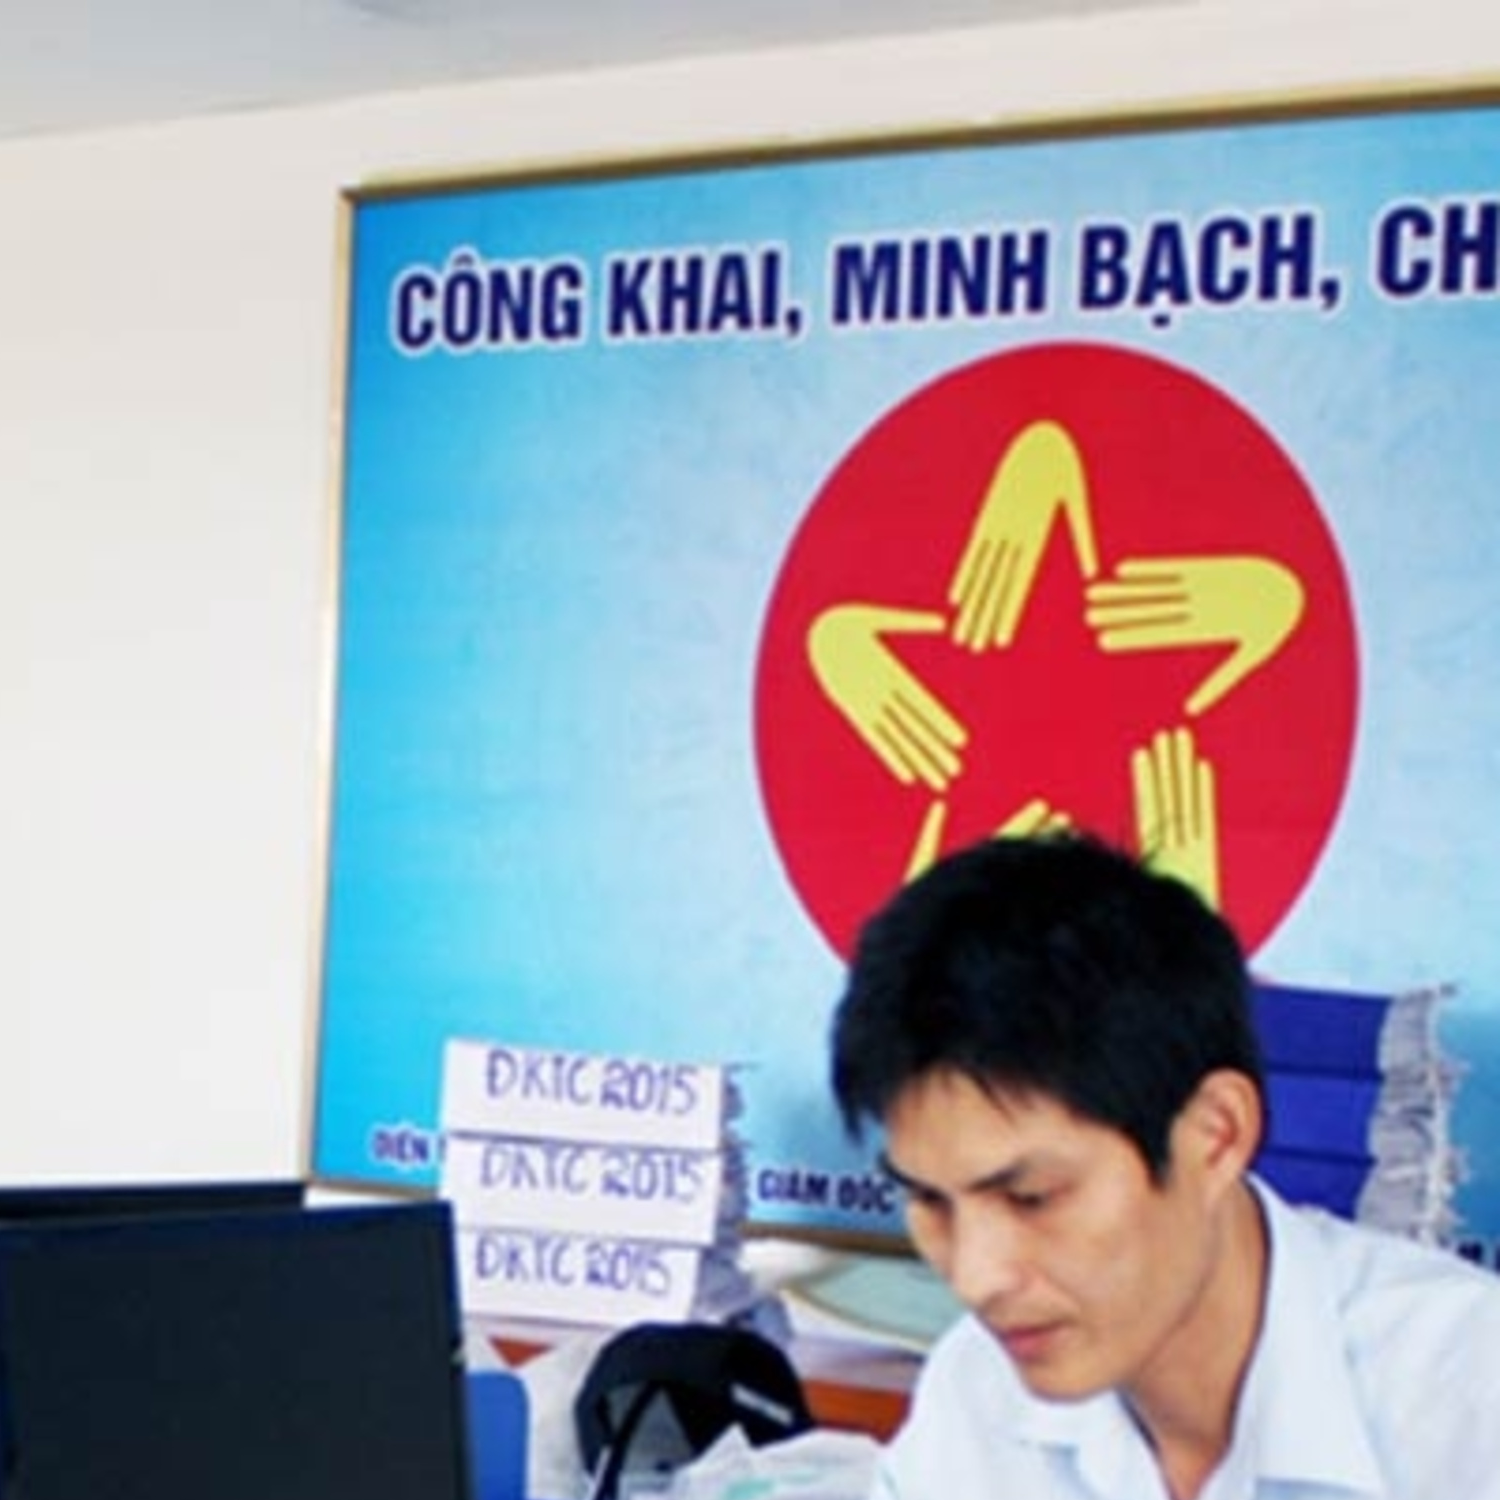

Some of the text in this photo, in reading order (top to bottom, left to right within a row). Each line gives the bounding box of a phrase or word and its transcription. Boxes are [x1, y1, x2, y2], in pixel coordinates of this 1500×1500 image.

[398, 252, 583, 350] CÔNG
[606, 249, 802, 338] KHAI,
[831, 227, 1049, 326] MINH
[1078, 213, 1340, 328] BẠCH,
[600, 1058, 699, 1116] 2015
[600, 1148, 704, 1203] 2015
